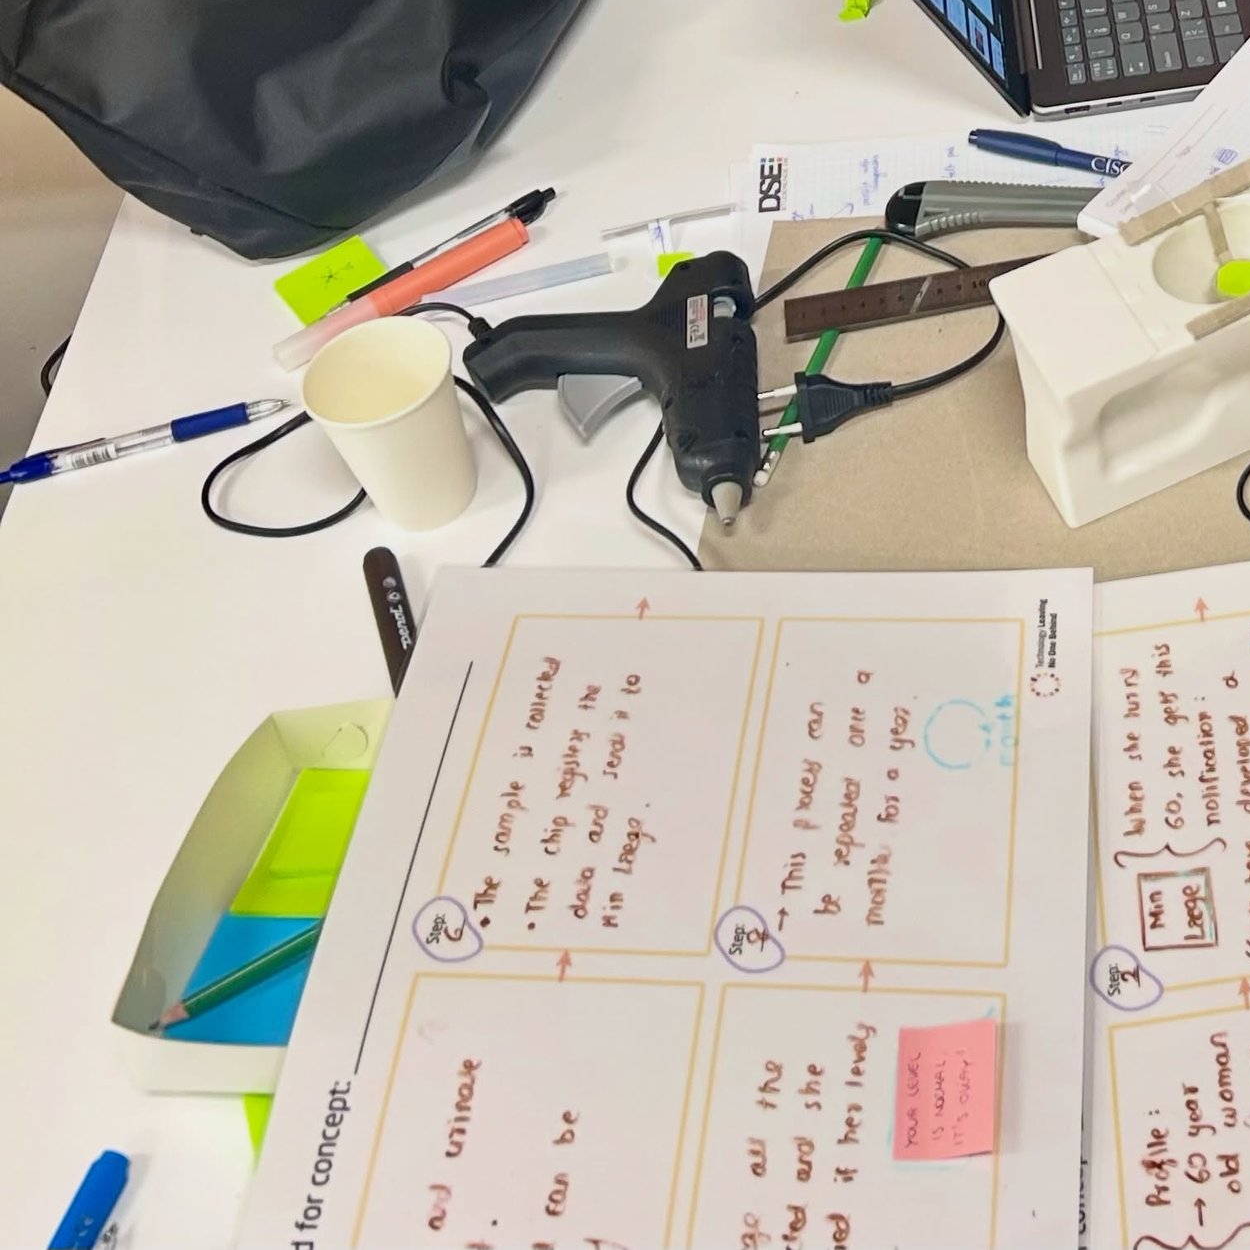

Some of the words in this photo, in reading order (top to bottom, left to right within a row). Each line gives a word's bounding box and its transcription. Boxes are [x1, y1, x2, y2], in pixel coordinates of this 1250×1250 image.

[759, 160, 782, 213] DSE
[1039, 598, 1048, 628] Leaving
[1049, 612, 1058, 638] Behind
[1036, 627, 1047, 669] Technology
[1153, 642, 1171, 679] this
[857, 669, 875, 685] a
[1223, 670, 1239, 689] a
[1123, 731, 1143, 762] she
[1164, 745, 1185, 778] she
[887, 768, 900, 781] a
[525, 877, 550, 914] The
[540, 814, 577, 856] chip
[578, 684, 602, 711] the
[877, 795, 900, 823] for
[586, 804, 609, 844] and
[473, 875, 501, 911] The
[494, 780, 528, 857] sample
[781, 852, 806, 895] This
[426, 912, 446, 945] Step:
[1149, 890, 1165, 929] Min
[729, 923, 748, 955] Step:
[1107, 962, 1121, 997] Step:
[1120, 964, 1138, 984] 2
[757, 1059, 784, 1110] the
[799, 1062, 825, 1112] she
[906, 1052, 922, 1098] LEVEL
[1209, 1030, 1238, 1128] woman
[445, 1058, 482, 1158] urinate
[553, 1110, 579, 1145] be
[837, 1105, 862, 1145] her
[904, 1106, 922, 1149] YOUR
[1182, 1082, 1216, 1137] year
[932, 1126, 944, 1141] IS
[295, 1195, 324, 1231] for
[311, 1080, 353, 1187] concept:
[796, 1136, 815, 1182] and
[1184, 1152, 1211, 1183] 60
[1216, 1153, 1242, 1195] old
[545, 1173, 569, 1217] can
